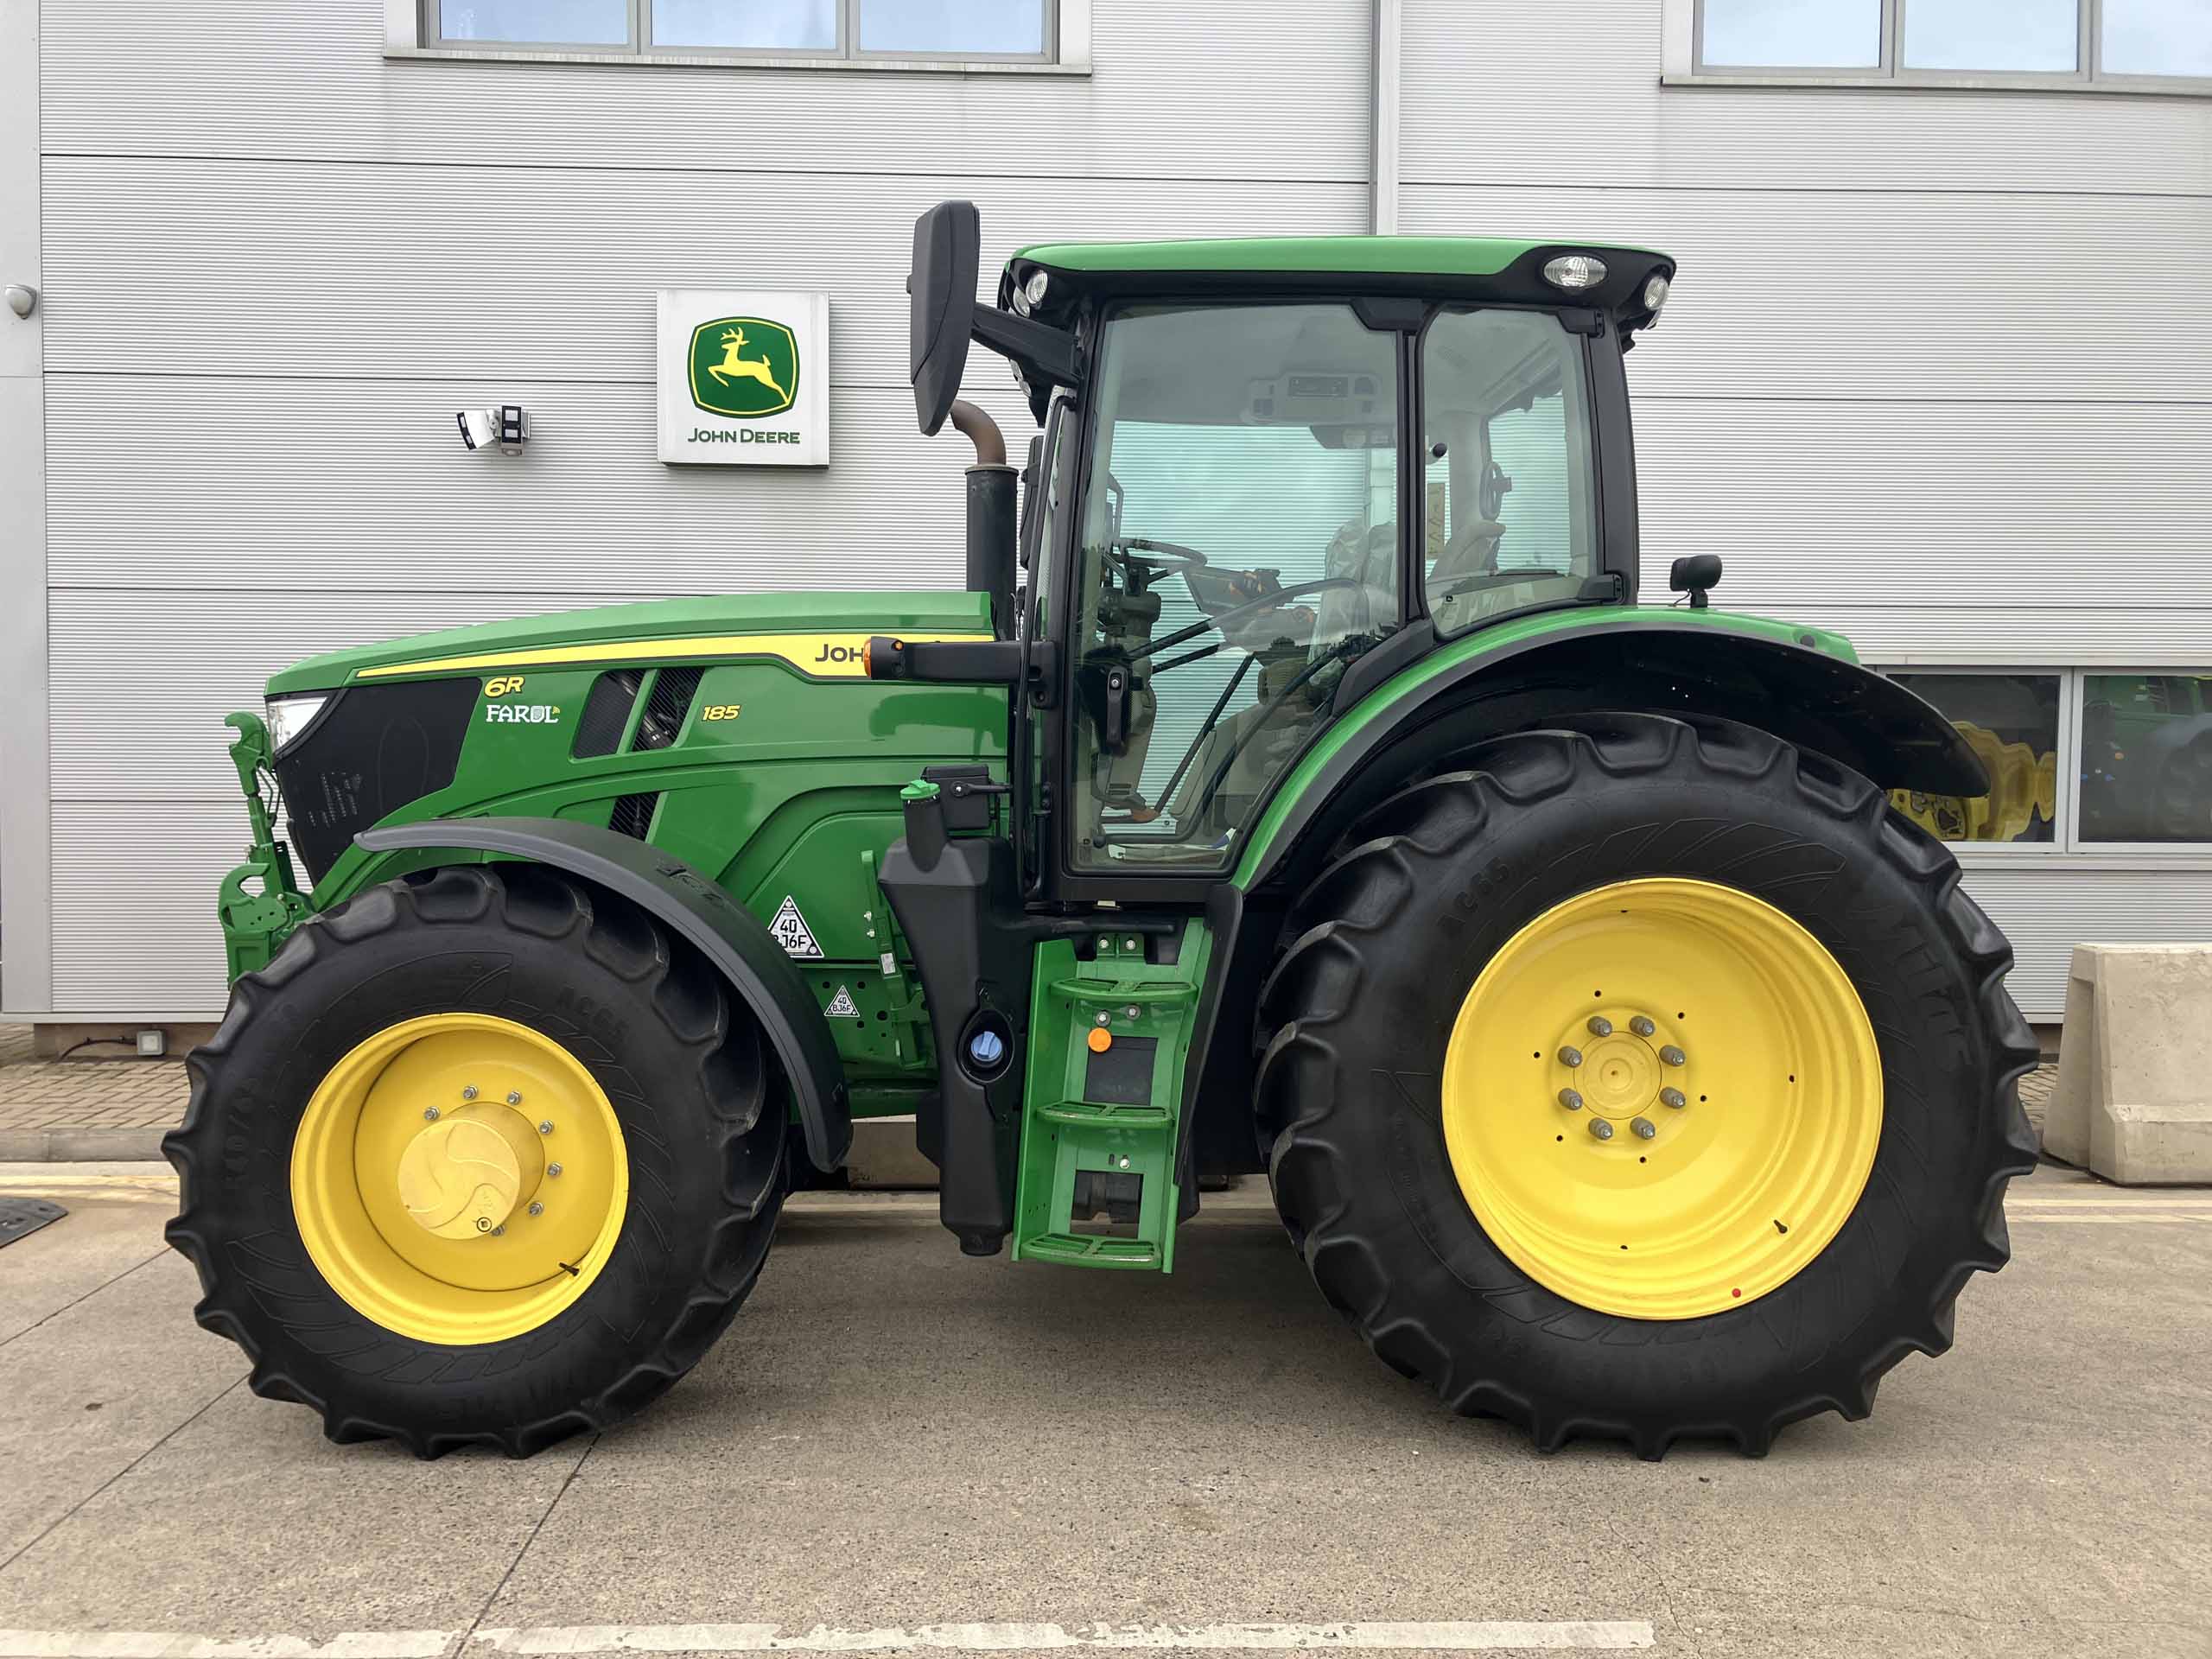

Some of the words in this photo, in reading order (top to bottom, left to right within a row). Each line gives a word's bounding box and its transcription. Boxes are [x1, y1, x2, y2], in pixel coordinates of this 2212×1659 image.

[688, 428, 737, 443] JOHN
[740, 429, 800, 444] DEERE
[815, 644, 864, 663] JOH
[484, 676, 524, 698] 6R
[486, 704, 559, 723] FAROL
[702, 704, 741, 721] 185
[779, 918, 798, 934] 40
